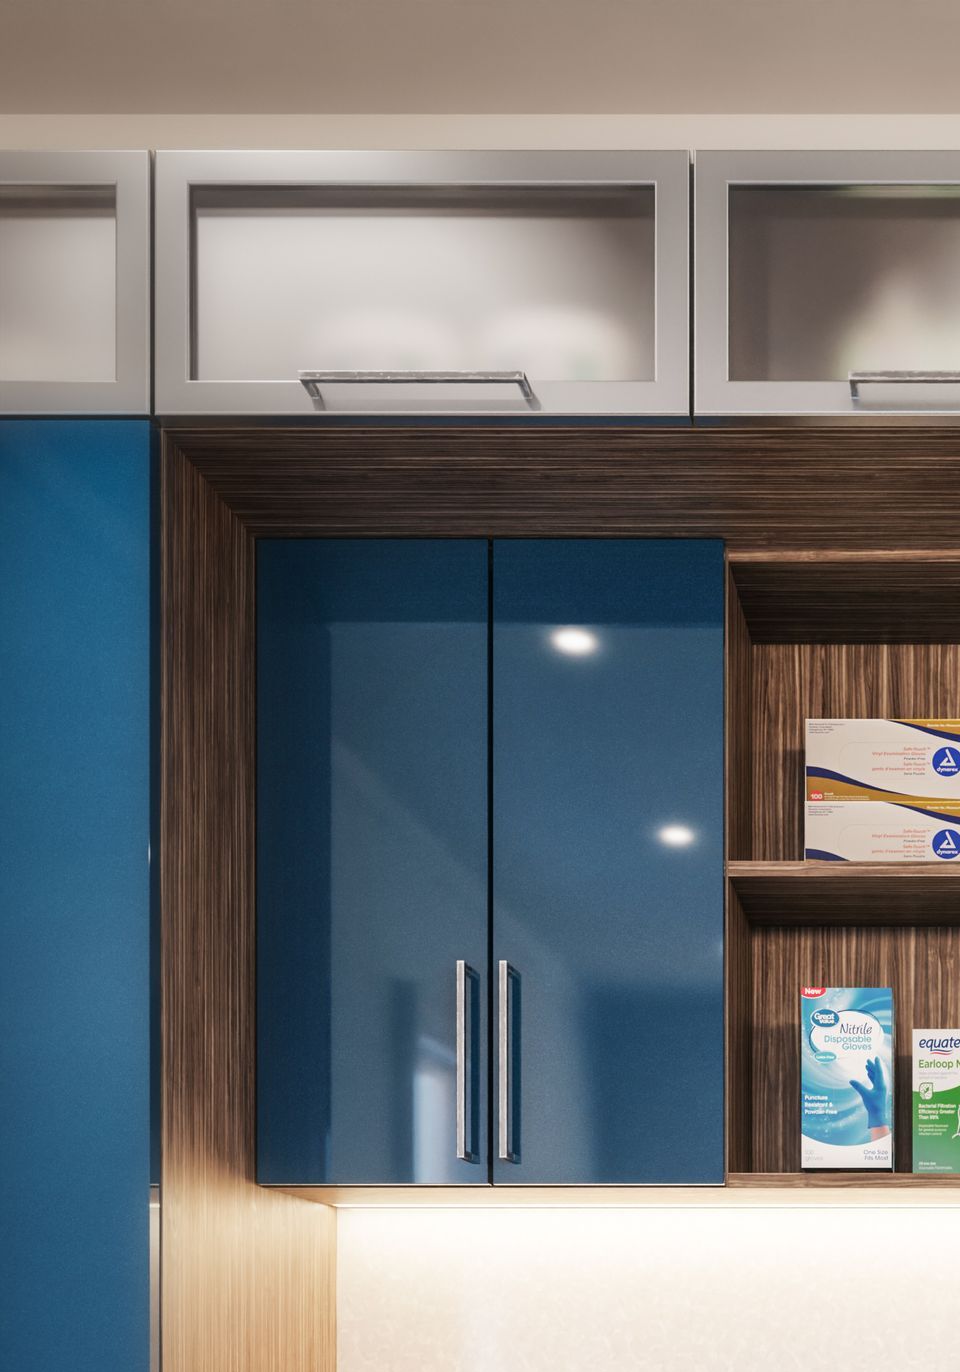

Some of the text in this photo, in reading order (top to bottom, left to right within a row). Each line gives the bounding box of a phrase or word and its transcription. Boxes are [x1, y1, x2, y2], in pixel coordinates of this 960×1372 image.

[840, 1022, 873, 1035] Nitrile
[824, 1035, 872, 1044] Disposable
[919, 1036, 960, 1051] equate
[918, 1059, 954, 1070] Earloop
